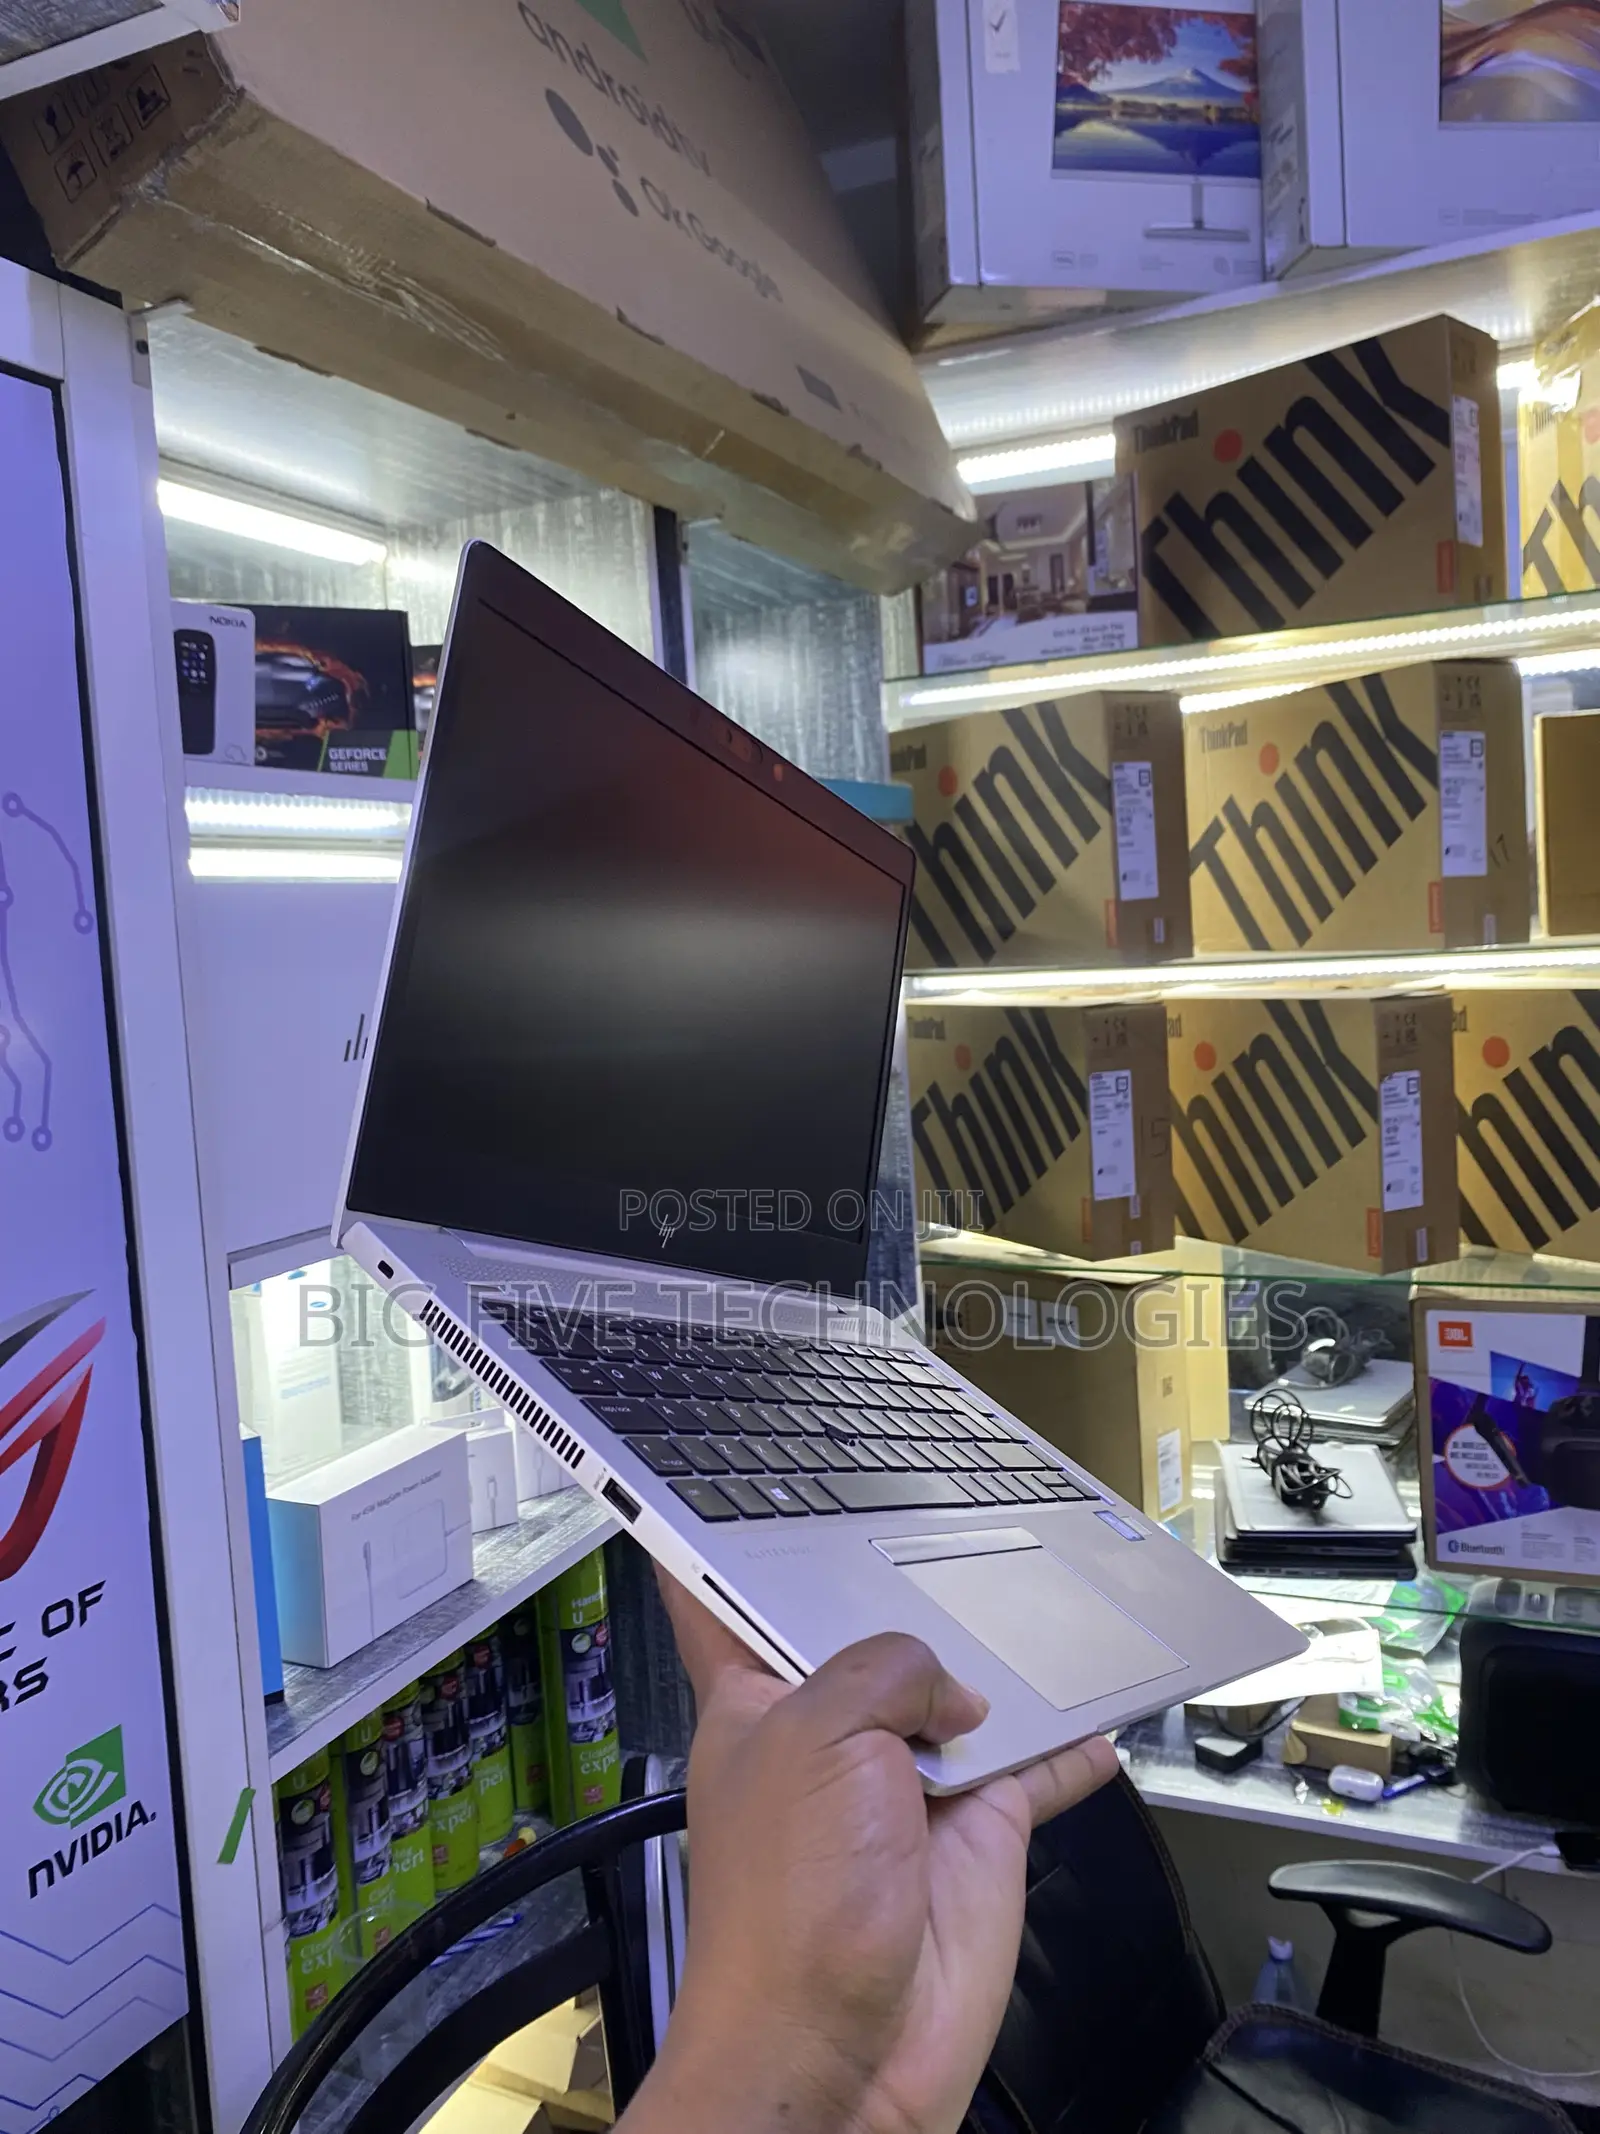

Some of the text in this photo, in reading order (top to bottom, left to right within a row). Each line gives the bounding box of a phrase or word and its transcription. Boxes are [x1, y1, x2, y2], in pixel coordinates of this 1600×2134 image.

[209, 614, 247, 629] NOKIA
[1201, 719, 1248, 753] ThinkPad
[329, 747, 387, 761] GEFORCE
[330, 761, 369, 772] SERIES
[1189, 673, 1440, 951] Think
[1170, 1000, 1380, 1244] hink
[1443, 1327, 1469, 1342] JBL
[1460, 1540, 1505, 1556] Bluetooth
[41, 1580, 106, 1638] OF
